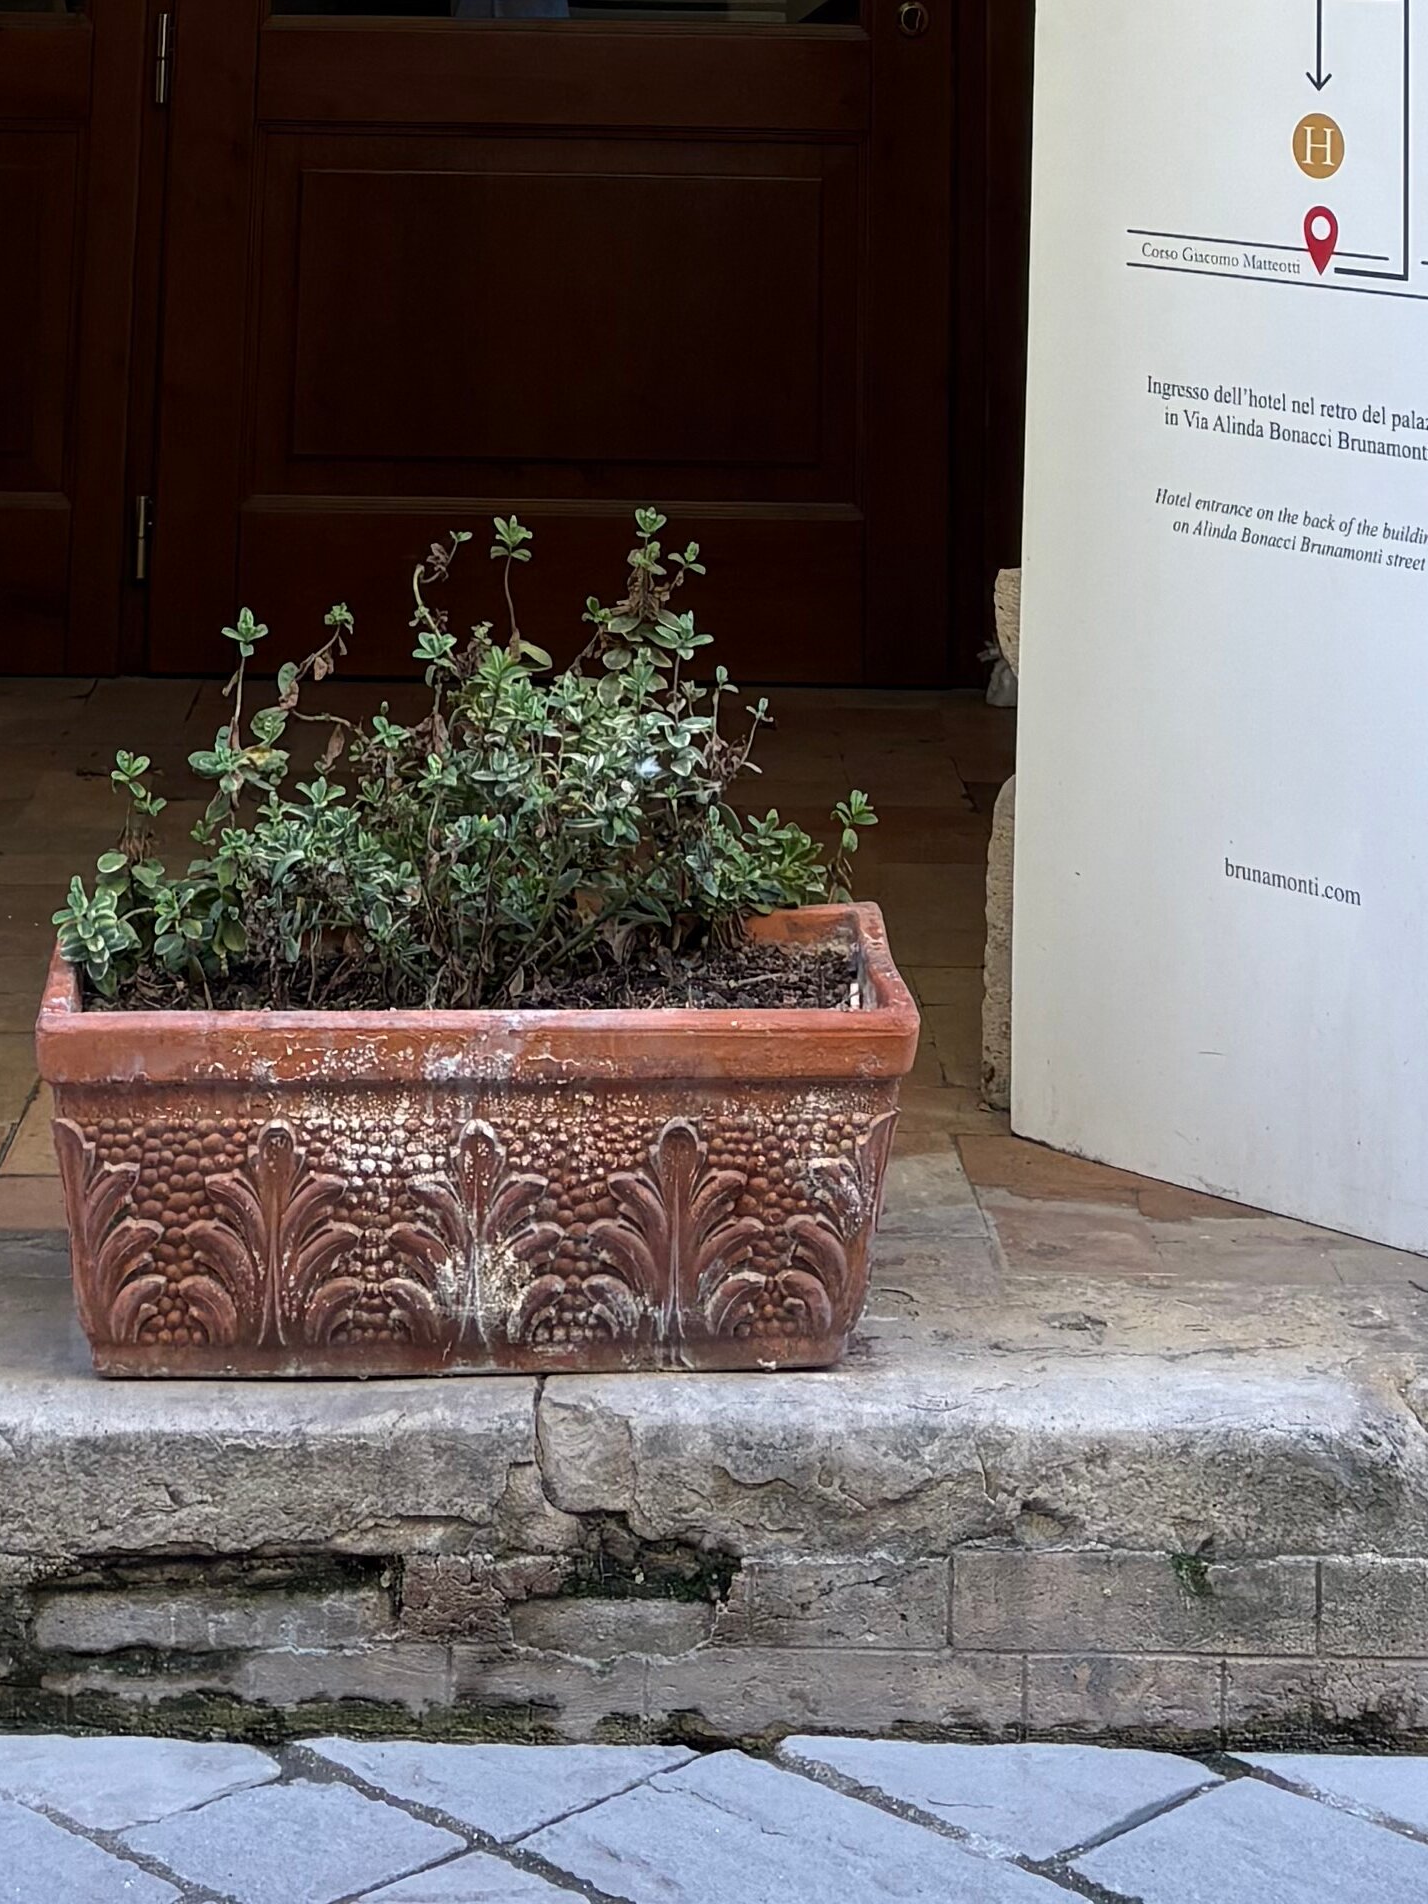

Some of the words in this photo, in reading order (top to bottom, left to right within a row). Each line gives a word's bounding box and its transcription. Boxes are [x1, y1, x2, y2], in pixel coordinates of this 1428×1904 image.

[1302, 126, 1335, 167] H
[1141, 242, 1179, 262] Corso
[1182, 246, 1239, 268] Giacomo
[1243, 253, 1301, 275] Matteotti
[1147, 375, 1209, 401] Ingresso
[1292, 397, 1315, 416] nel
[1320, 403, 1357, 421] retro
[1362, 404, 1386, 425] del
[1164, 406, 1179, 426] in
[1183, 410, 1209, 431] Via
[1213, 416, 1264, 439] Alinda
[1270, 421, 1332, 448] Bonacci
[1155, 488, 1192, 508] Hotel
[1195, 497, 1253, 518] entrance
[1256, 508, 1274, 521] on
[1277, 509, 1299, 525] the
[1302, 511, 1335, 531] back
[1339, 517, 1356, 538] of
[1356, 518, 1378, 537] the
[1173, 520, 1190, 533] on
[1193, 521, 1237, 541] Alinda
[1241, 528, 1296, 551] Bonacci
[1300, 536, 1382, 565] Brunamonti
[1386, 553, 1426, 571] street
[1225, 857, 1361, 905] brunamonti.com
